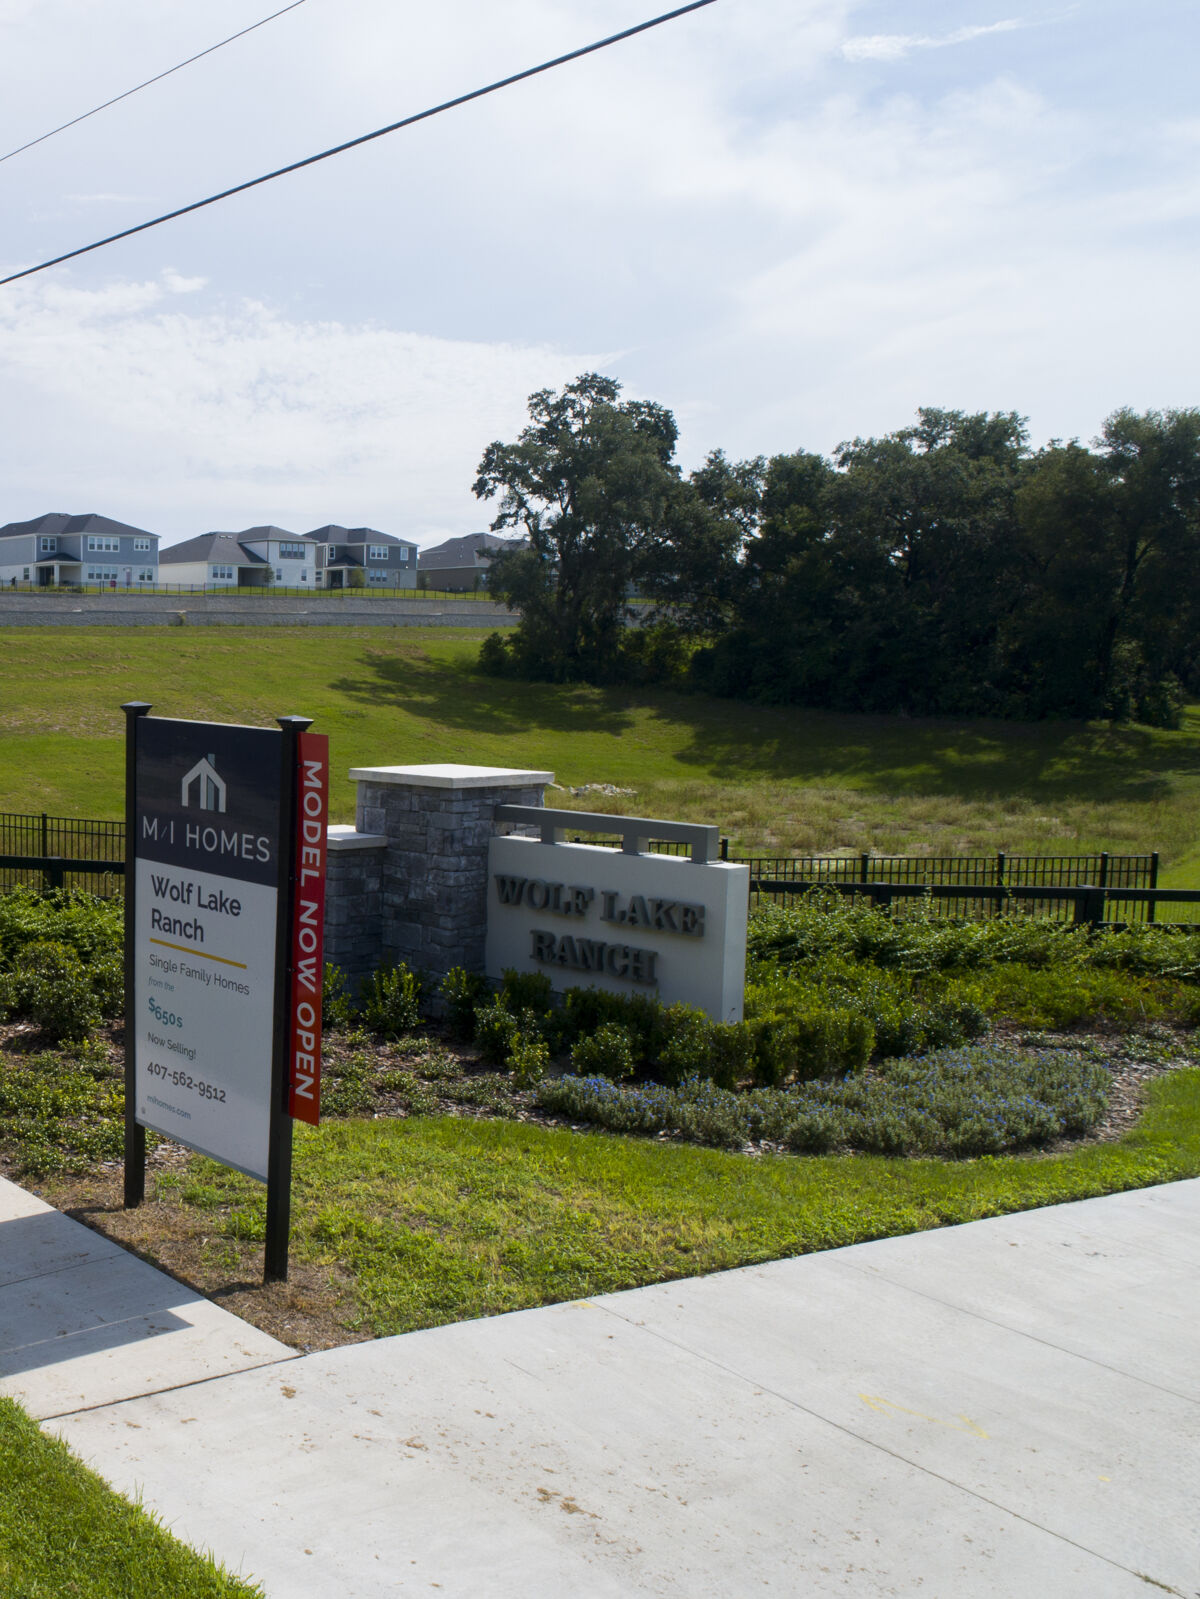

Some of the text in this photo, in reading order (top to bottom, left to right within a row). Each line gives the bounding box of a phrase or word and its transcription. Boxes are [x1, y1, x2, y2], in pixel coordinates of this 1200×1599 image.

[186, 823, 270, 862] HOMES
[151, 874, 241, 916] Wolf Lake
[494, 874, 706, 937] WOLF LAKE
[151, 908, 204, 942] Ranch
[295, 760, 322, 1100] MODEL NOW OPEN
[149, 954, 250, 995] Single Family Homes
[530, 929, 659, 986] RANCH
[148, 976, 175, 992] from the
[148, 996, 183, 1028] $650s
[147, 1031, 196, 1061] Now Selling!
[147, 1062, 226, 1103] 407-562-9512
